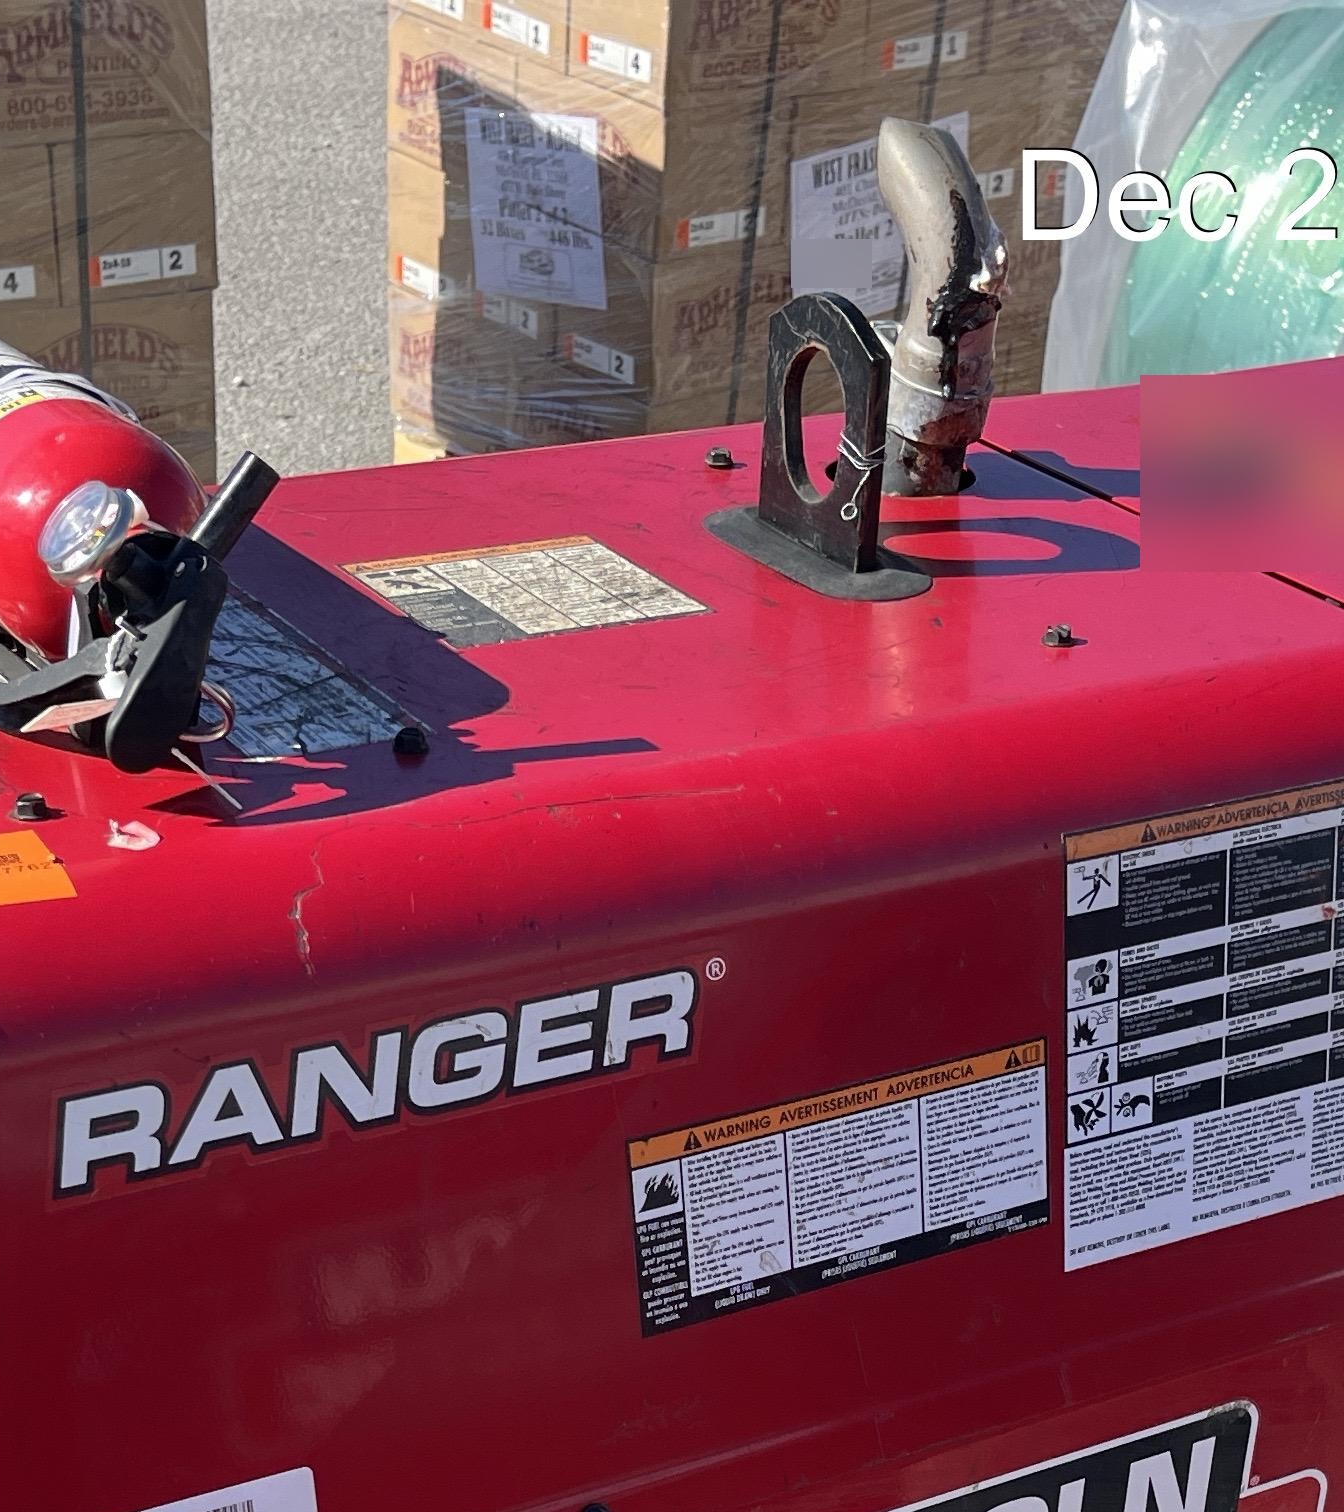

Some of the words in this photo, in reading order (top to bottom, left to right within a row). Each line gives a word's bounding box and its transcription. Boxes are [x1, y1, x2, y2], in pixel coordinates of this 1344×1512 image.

[533, 24, 541, 47] 1
[946, 35, 957, 56] 1
[630, 52, 641, 74] 4
[847, 146, 877, 178] FRAS
[991, 174, 1004, 193] 2
[168, 250, 183, 270] 2
[3, 272, 18, 293] 4
[613, 358, 624, 375] 2
[1156, 815, 1206, 837] WARNING
[1217, 801, 1290, 826] ADVERTENCIA
[60, 969, 696, 1190] RANGER
[703, 1115, 771, 1144] WARNING
[778, 1088, 879, 1124] AVERTISSEMENT
[886, 1063, 975, 1097] ADVERTENCIA
